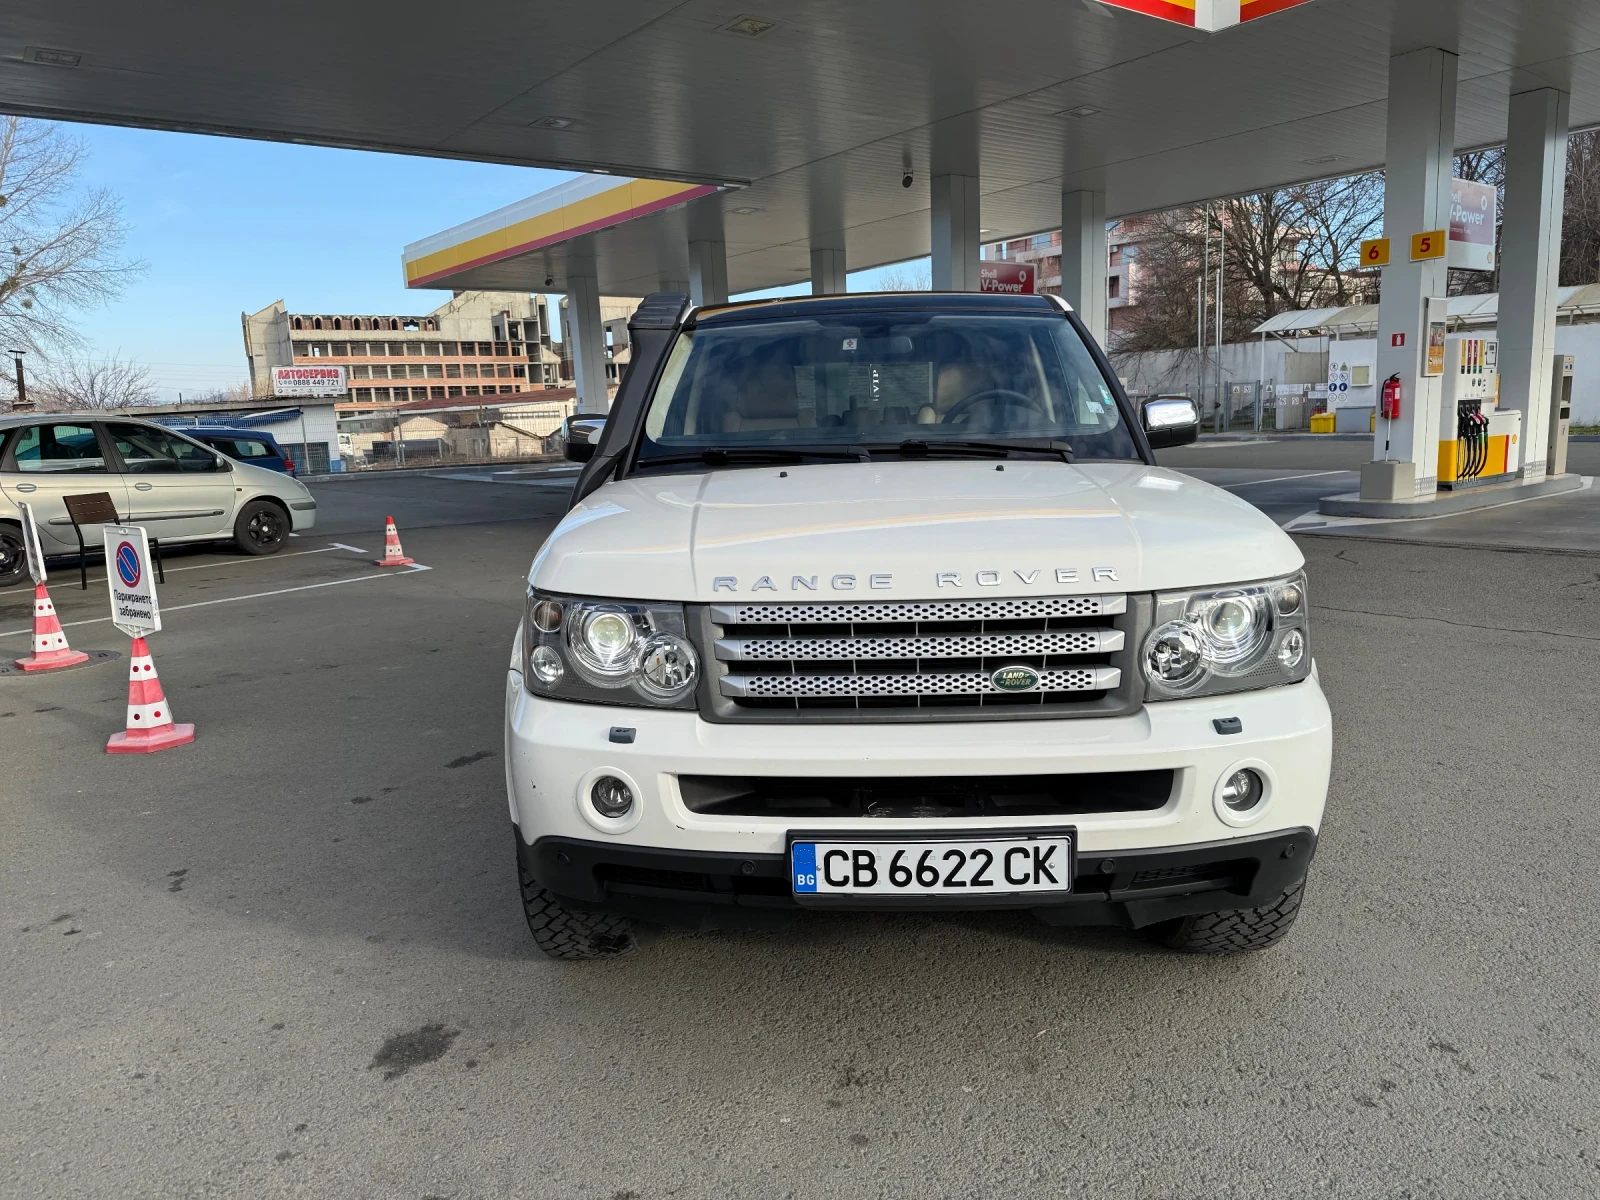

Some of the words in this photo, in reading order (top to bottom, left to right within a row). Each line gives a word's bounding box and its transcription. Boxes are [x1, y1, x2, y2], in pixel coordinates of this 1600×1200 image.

[1419, 237, 1431, 253] 5
[1368, 245, 1380, 260] 6
[980, 269, 998, 279] Shell
[981, 279, 1023, 292] V-Power
[278, 369, 339, 379] АВТОСЕРВИЗ
[712, 573, 894, 592] RANGE
[936, 565, 1119, 588] ROVER
[119, 606, 151, 619] забранено
[1002, 671, 1025, 679] LAND
[1004, 678, 1032, 686] ROVER
[823, 848, 879, 888] CB
[888, 848, 994, 888] 6622
[1004, 844, 1060, 887] CK
[797, 874, 815, 886] BG
